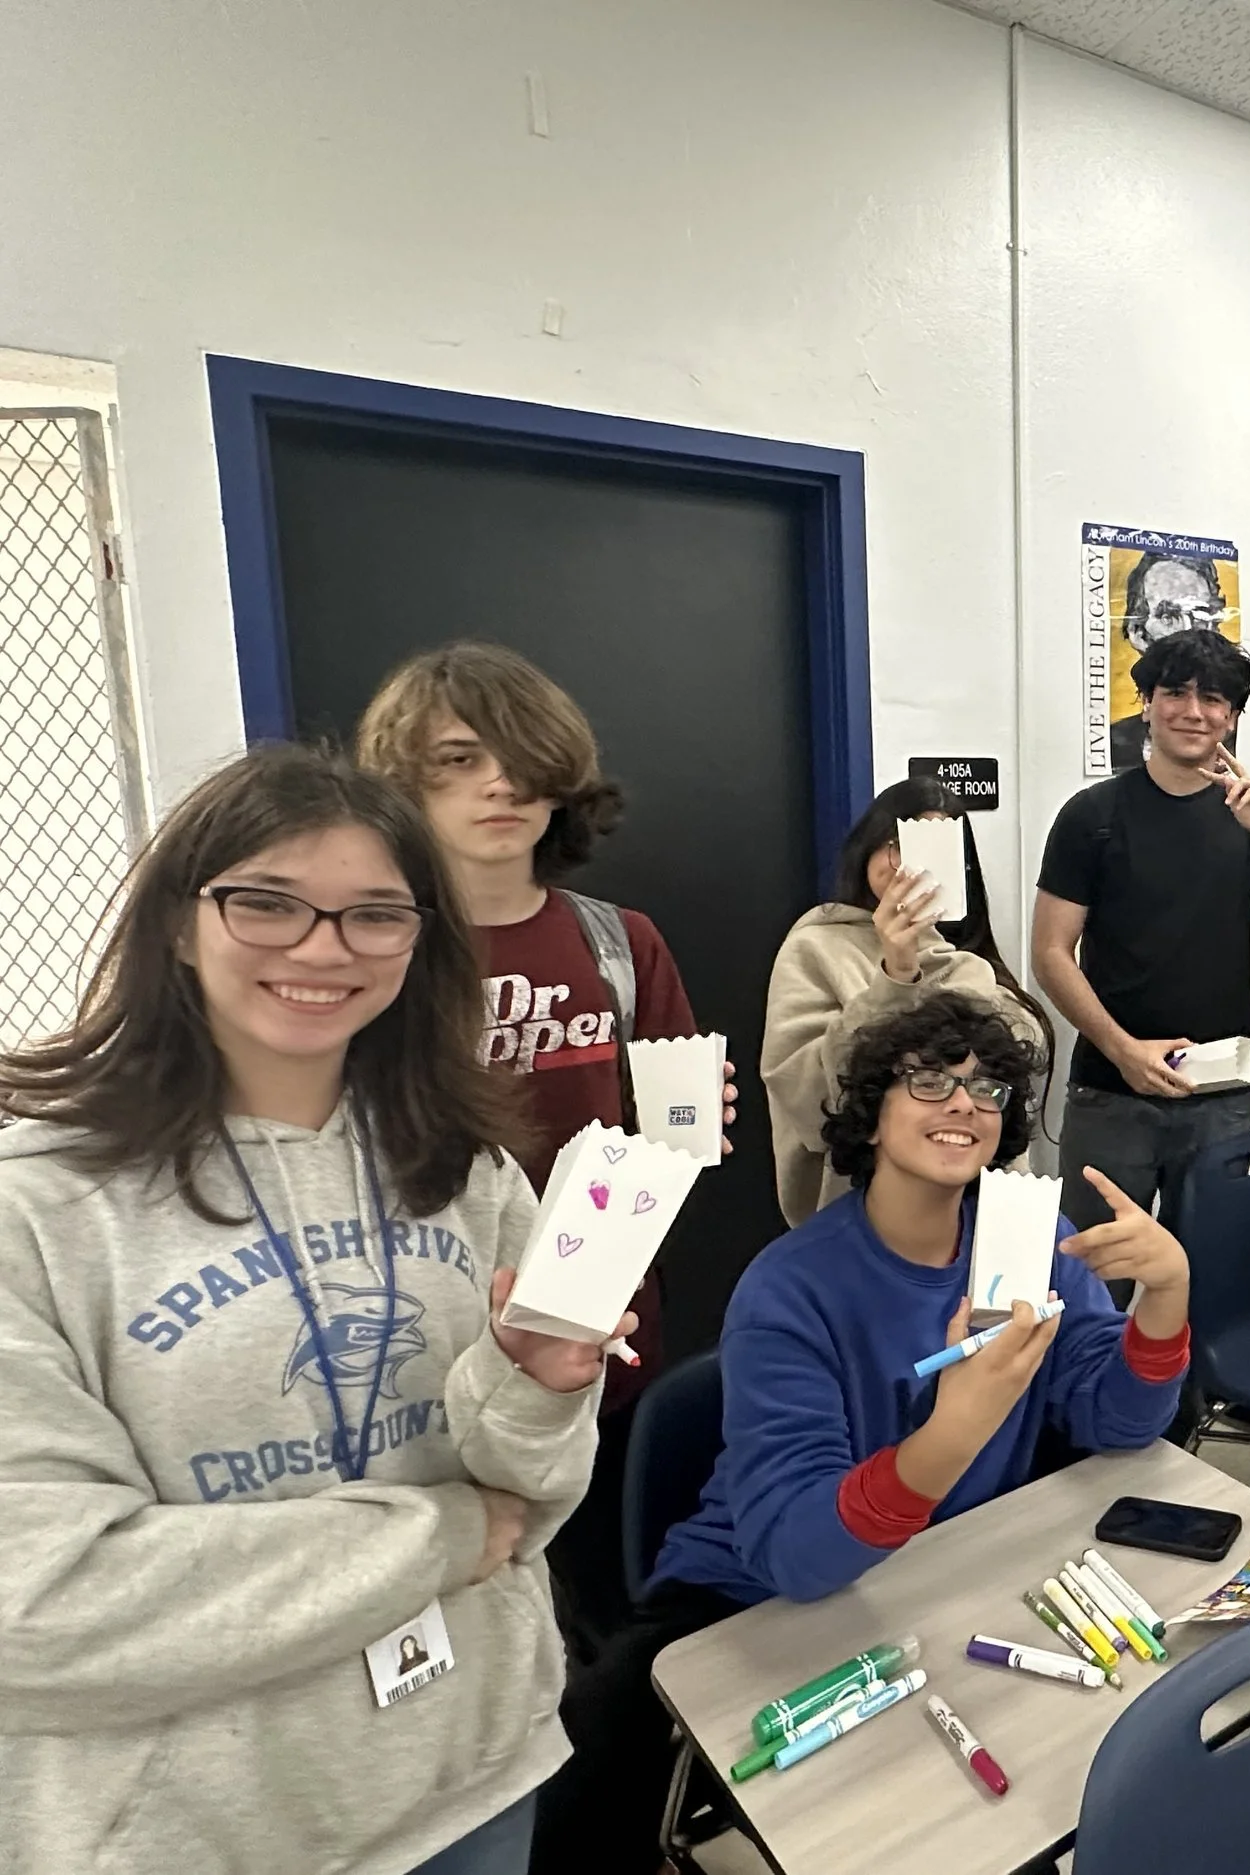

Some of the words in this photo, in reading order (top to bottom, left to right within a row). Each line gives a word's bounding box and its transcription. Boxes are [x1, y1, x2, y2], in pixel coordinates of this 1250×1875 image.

[1174, 540, 1199, 552] 200th
[1200, 541, 1236, 557] Birthday
[1088, 547, 1105, 648] LEGACY
[1089, 655, 1105, 708] THE
[1089, 714, 1106, 769] LIVE
[937, 763, 972, 778] 4-105A
[965, 781, 996, 796] ROOM
[480, 974, 570, 1027] Dr
